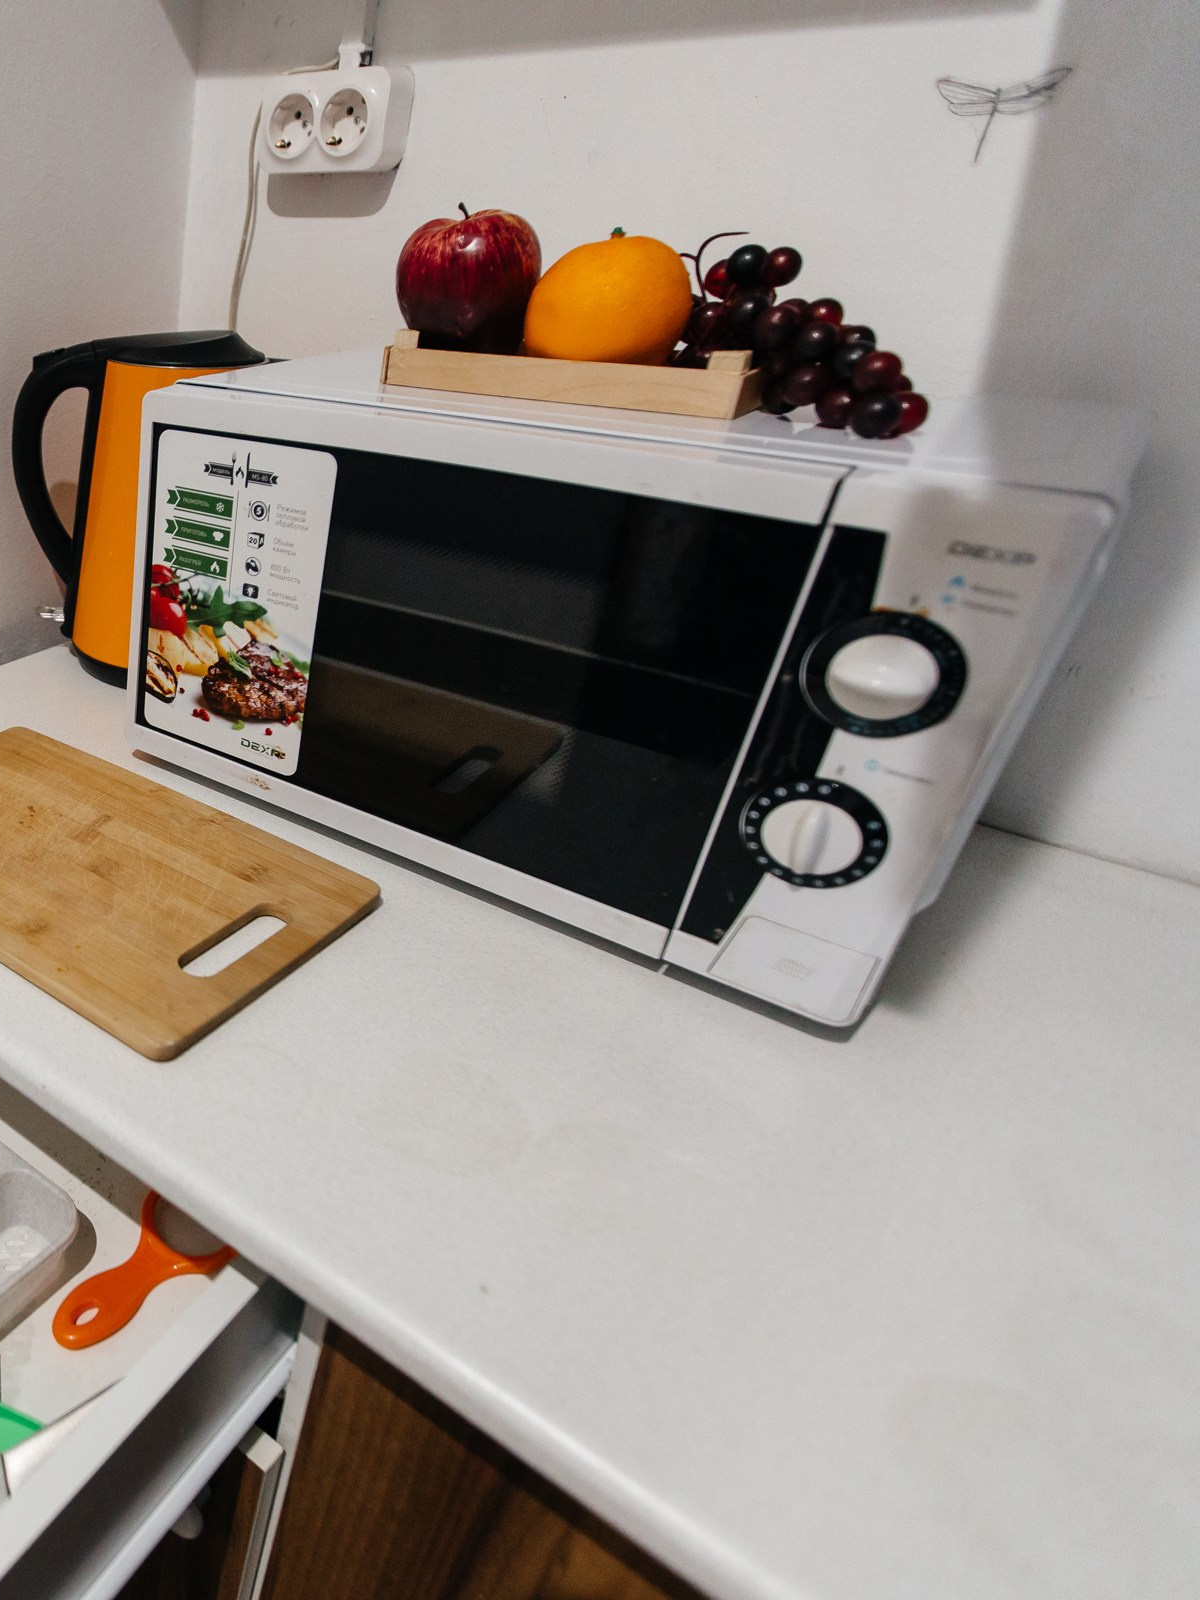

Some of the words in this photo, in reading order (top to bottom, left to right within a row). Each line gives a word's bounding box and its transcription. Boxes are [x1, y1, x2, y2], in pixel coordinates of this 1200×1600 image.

[182, 497, 210, 507] РАЗМОРОЗЬ
[255, 506, 262, 516] 5
[277, 504, 307, 515] Режимов
[276, 512, 307, 523] тепловой
[275, 520, 309, 533] обработки
[180, 527, 207, 537] ПРИГОТОВЬ
[249, 536, 257, 545] 20
[272, 547, 296, 557] камеры
[178, 556, 202, 566] РАЗОГРЕЙ
[269, 572, 302, 585] мощность
[267, 589, 297, 601] Световой
[266, 598, 299, 610] индикатор
